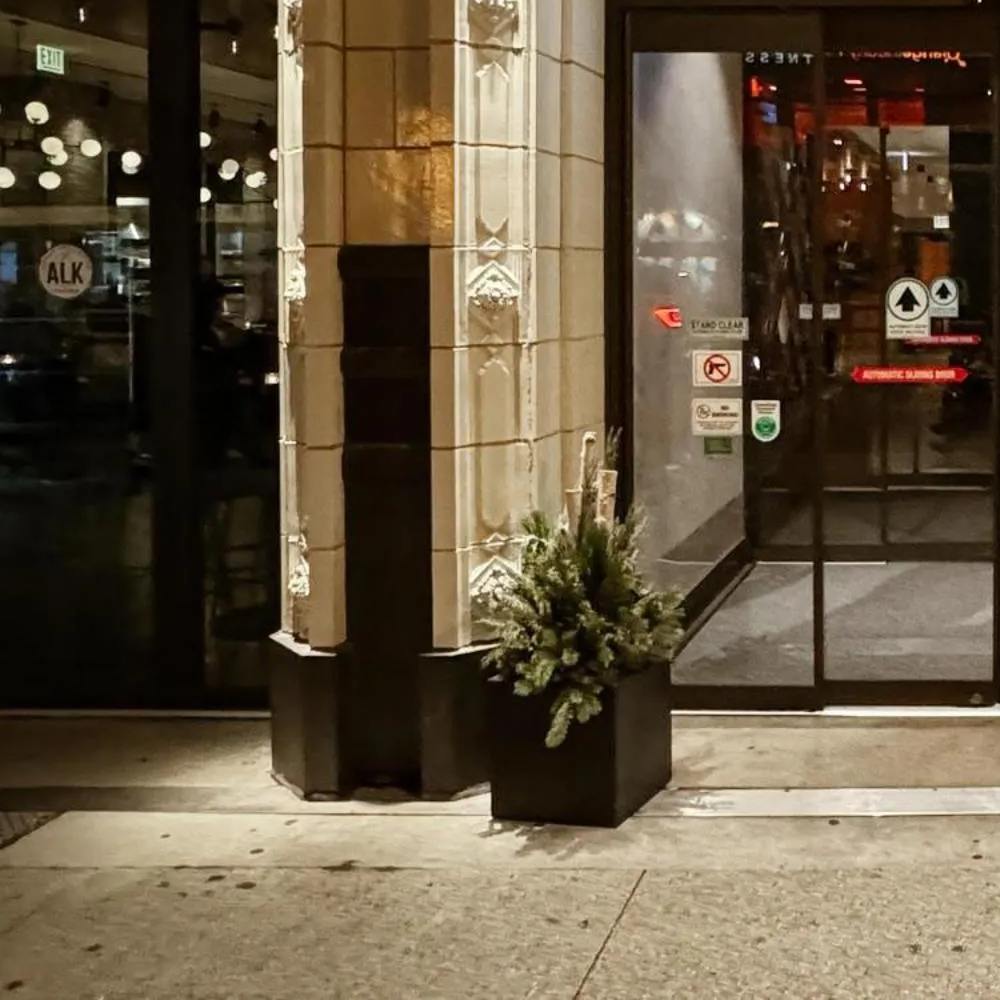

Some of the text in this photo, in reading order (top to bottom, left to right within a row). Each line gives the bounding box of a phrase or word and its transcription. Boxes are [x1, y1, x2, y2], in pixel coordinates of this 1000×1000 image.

[40, 47, 61, 68] EXIT
[46, 261, 84, 285] ALK
[690, 319, 744, 328] STAND CLEAR
